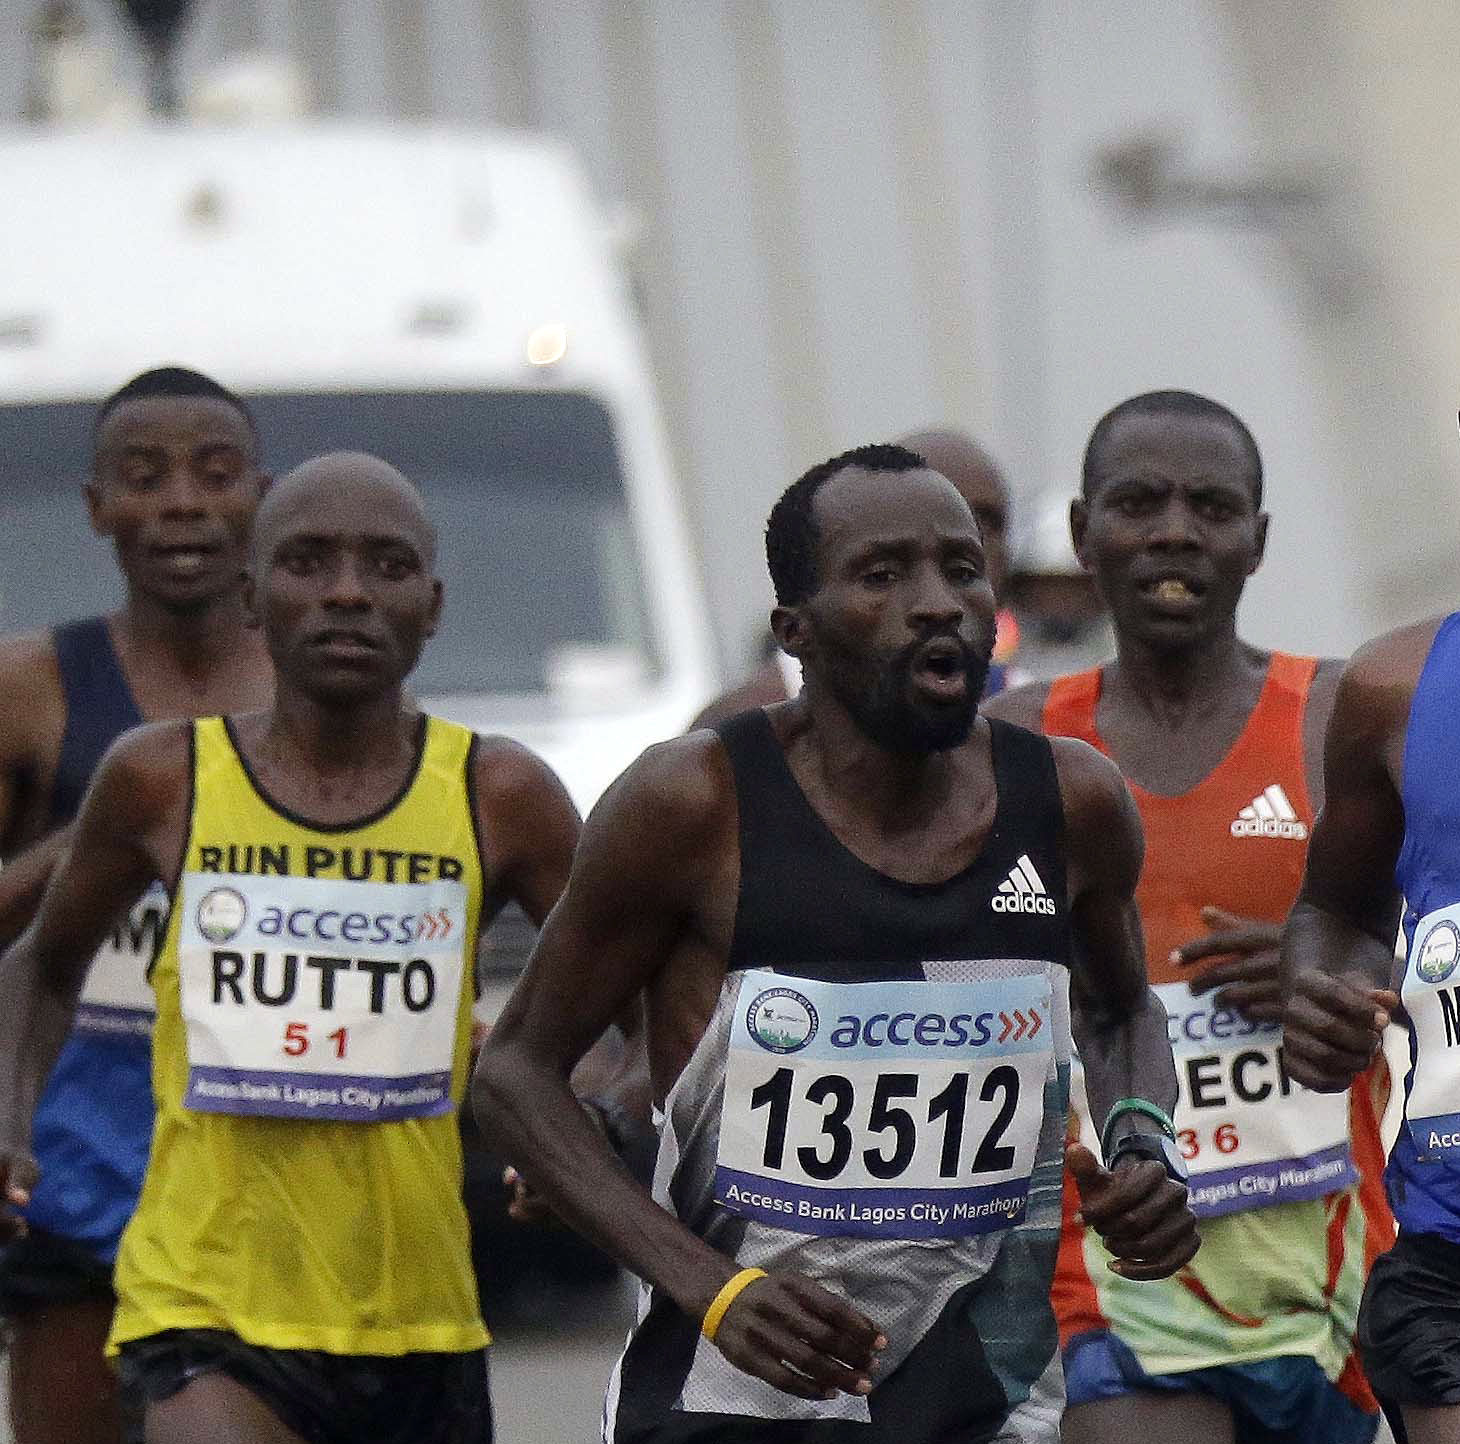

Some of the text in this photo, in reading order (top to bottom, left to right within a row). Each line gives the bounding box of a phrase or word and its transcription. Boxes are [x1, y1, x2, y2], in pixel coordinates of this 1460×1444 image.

[991, 890, 1056, 915] adidas
[257, 906, 416, 946] access
[212, 951, 436, 1014] RUTTO
[830, 1010, 993, 1050] access
[750, 1064, 1019, 1181] 13512
[725, 1183, 1023, 1225] Access Bank Lagos City Marathon
